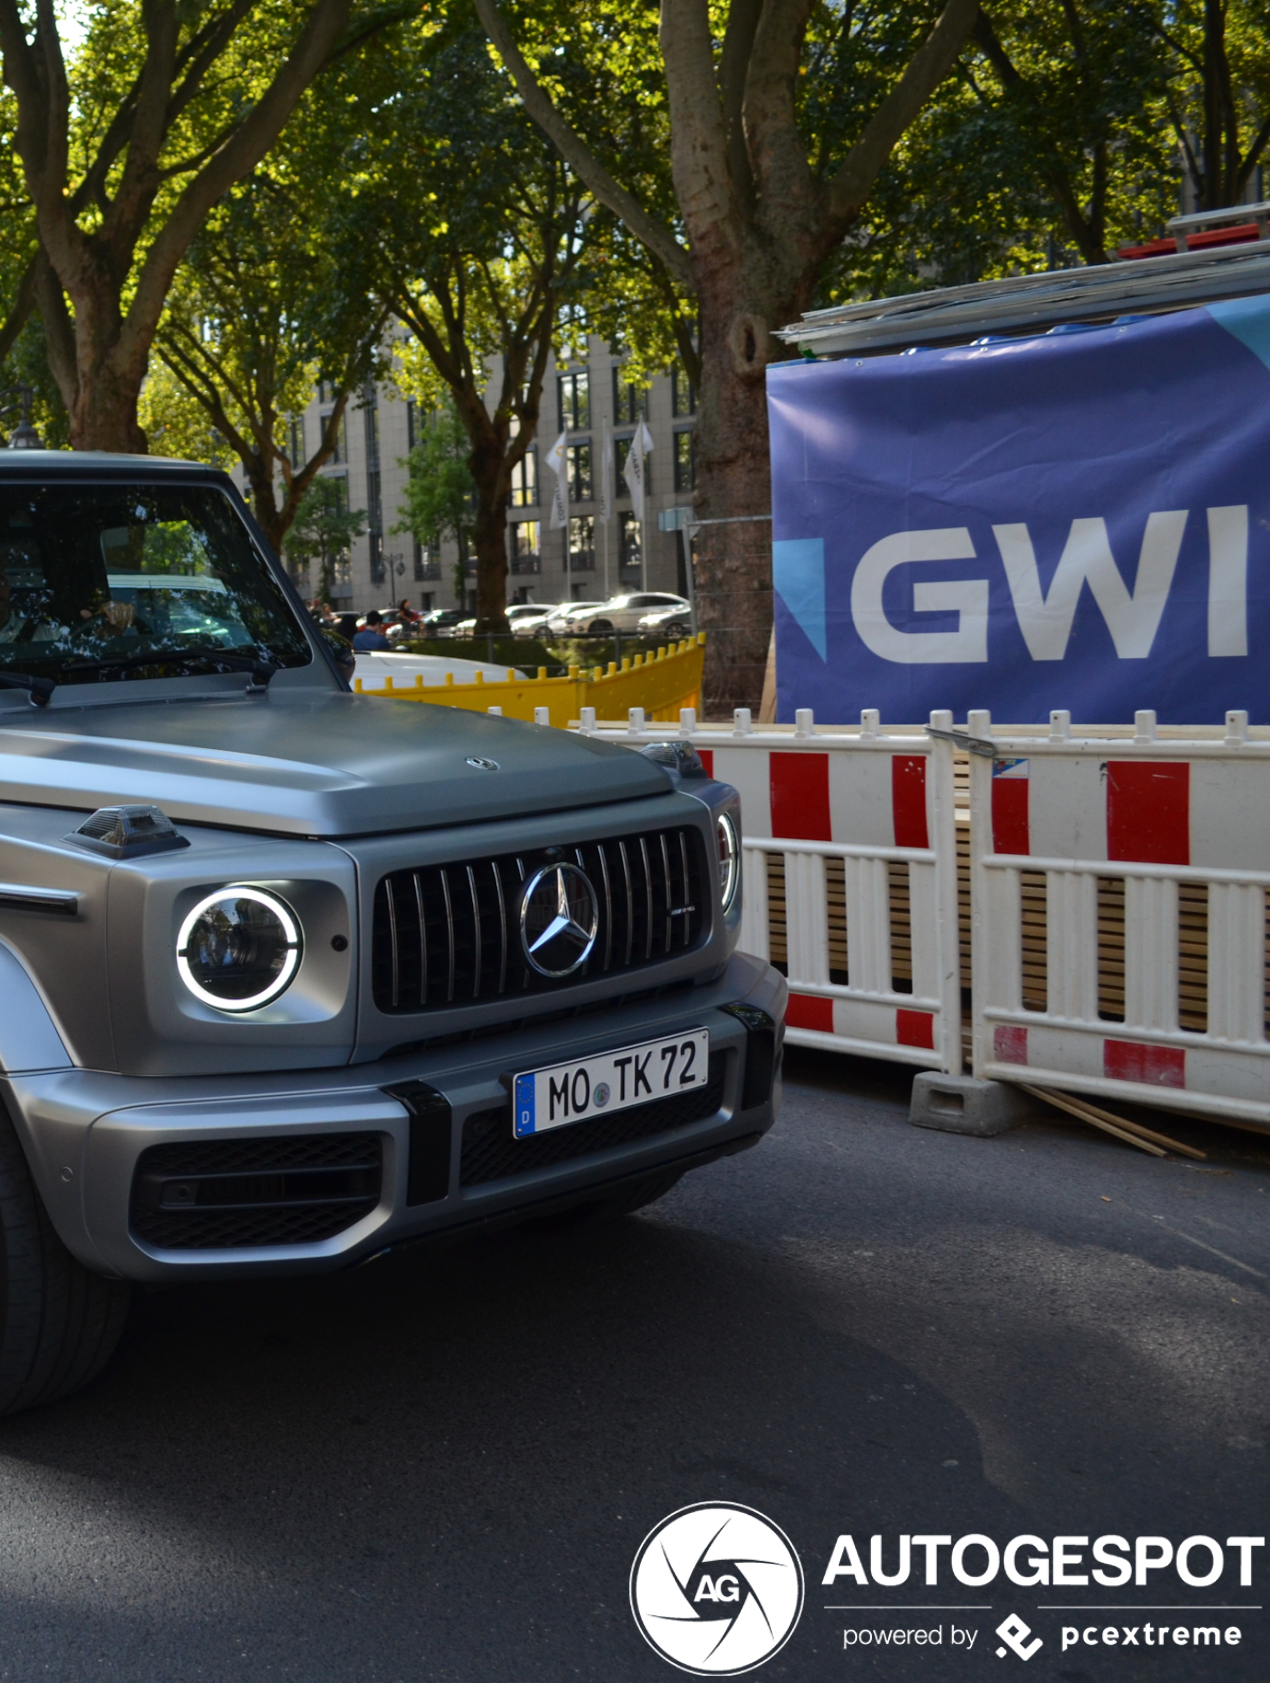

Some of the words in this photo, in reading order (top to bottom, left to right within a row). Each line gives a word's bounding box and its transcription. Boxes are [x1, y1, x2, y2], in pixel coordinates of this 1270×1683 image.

[851, 504, 1248, 664] GWI
[521, 1110, 530, 1125] D
[549, 1067, 590, 1121] MO
[614, 1051, 652, 1101] TK
[661, 1041, 696, 1089] 72
